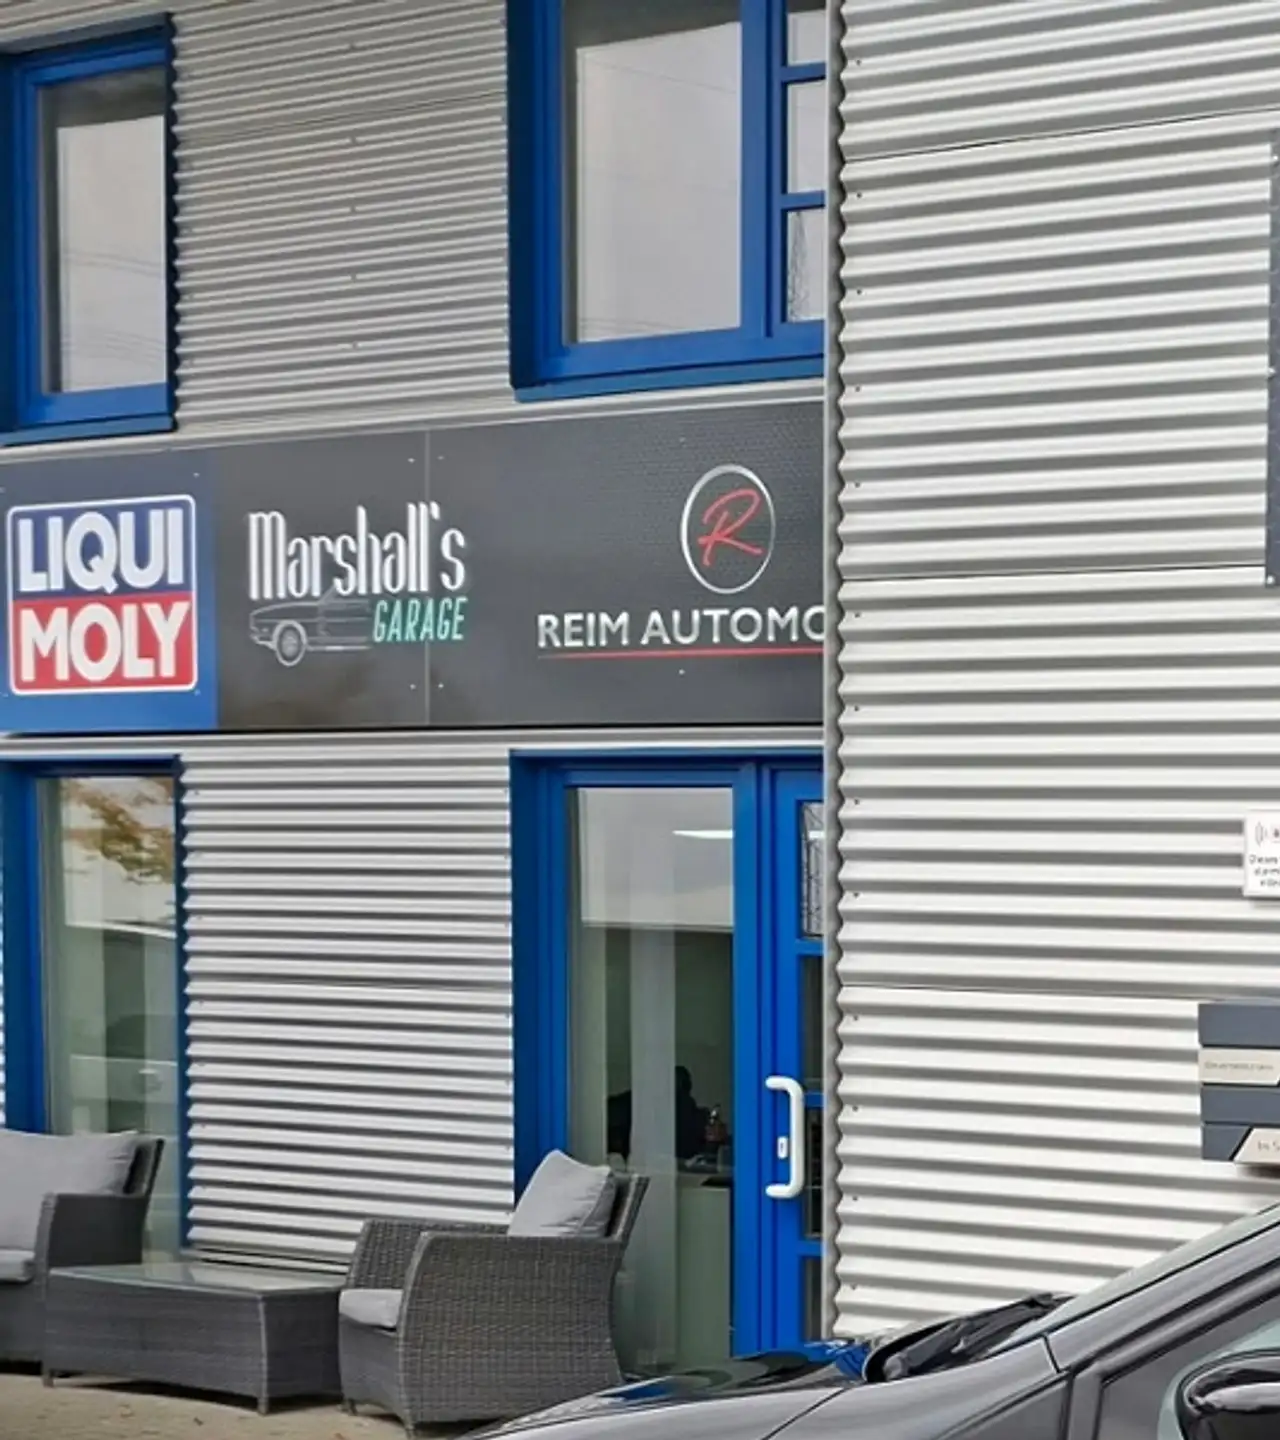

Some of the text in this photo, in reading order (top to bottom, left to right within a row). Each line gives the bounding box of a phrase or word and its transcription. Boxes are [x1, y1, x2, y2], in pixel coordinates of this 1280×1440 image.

[17, 507, 185, 594] LIQUI
[248, 500, 467, 600] Marshall's
[19, 601, 191, 682] MOLY
[371, 596, 469, 643] GARAGE
[537, 610, 630, 648] REIM
